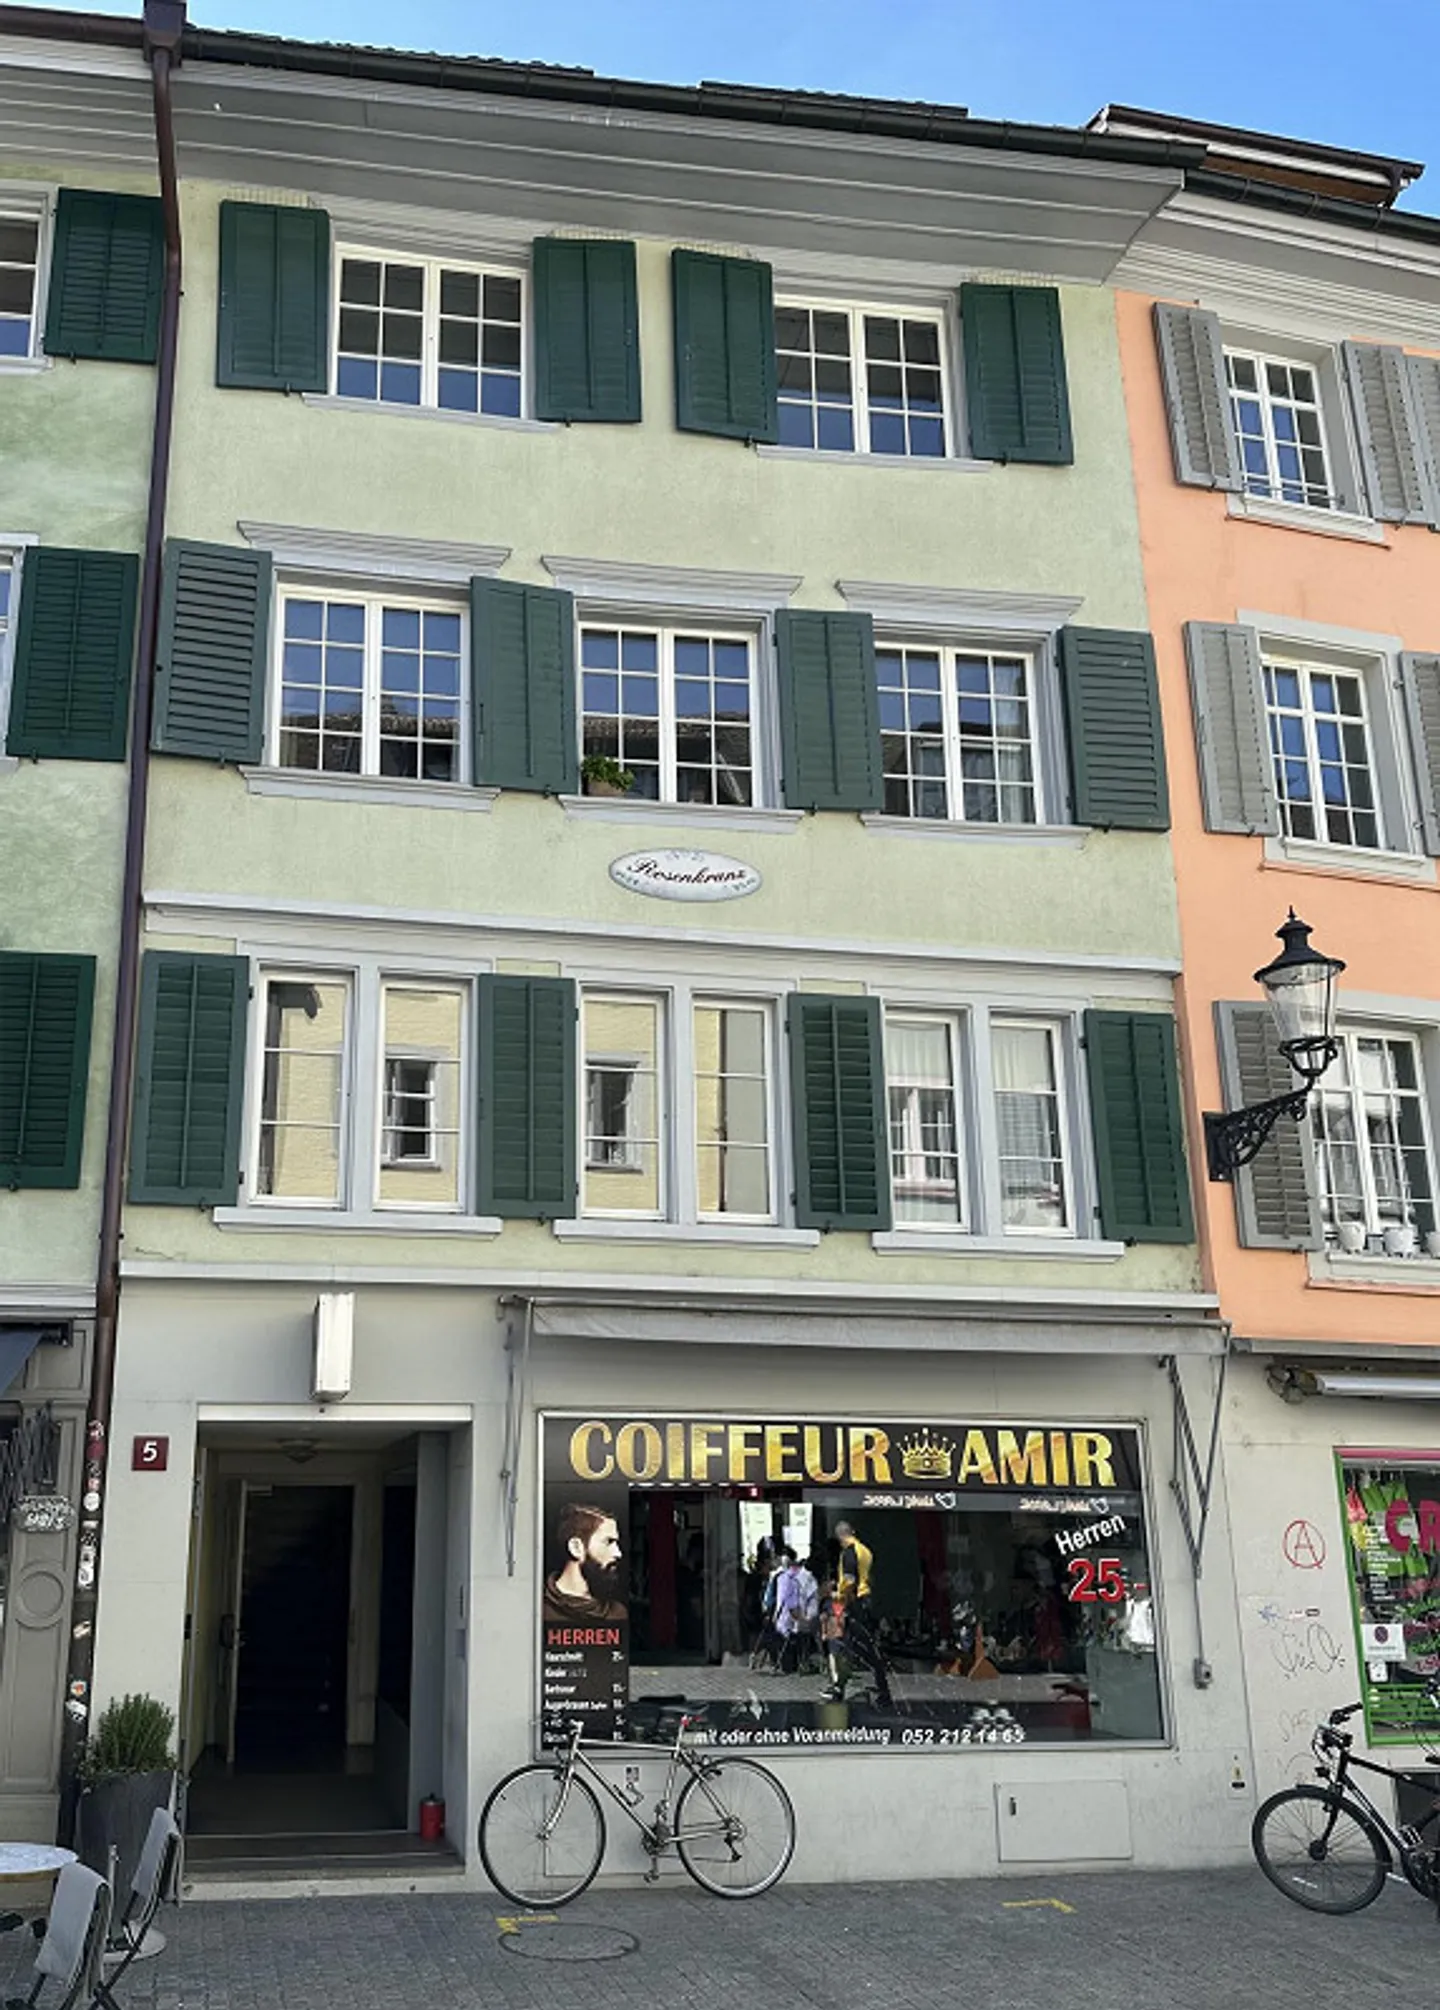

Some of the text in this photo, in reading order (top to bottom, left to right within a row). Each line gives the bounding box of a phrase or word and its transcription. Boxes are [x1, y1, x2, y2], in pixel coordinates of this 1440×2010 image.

[142, 1441, 158, 1462] 5
[569, 1420, 1117, 1487] COIFFEUR AMIR
[1055, 1515, 1126, 1555] Herren
[547, 1628, 620, 1646] HERREN
[694, 1728, 717, 1745] mit
[719, 1729, 752, 1745] oder
[753, 1728, 790, 1744] ohne
[792, 1726, 891, 1746] Voranmeldung
[902, 1729, 934, 1745] 052
[939, 1728, 972, 1745] 212
